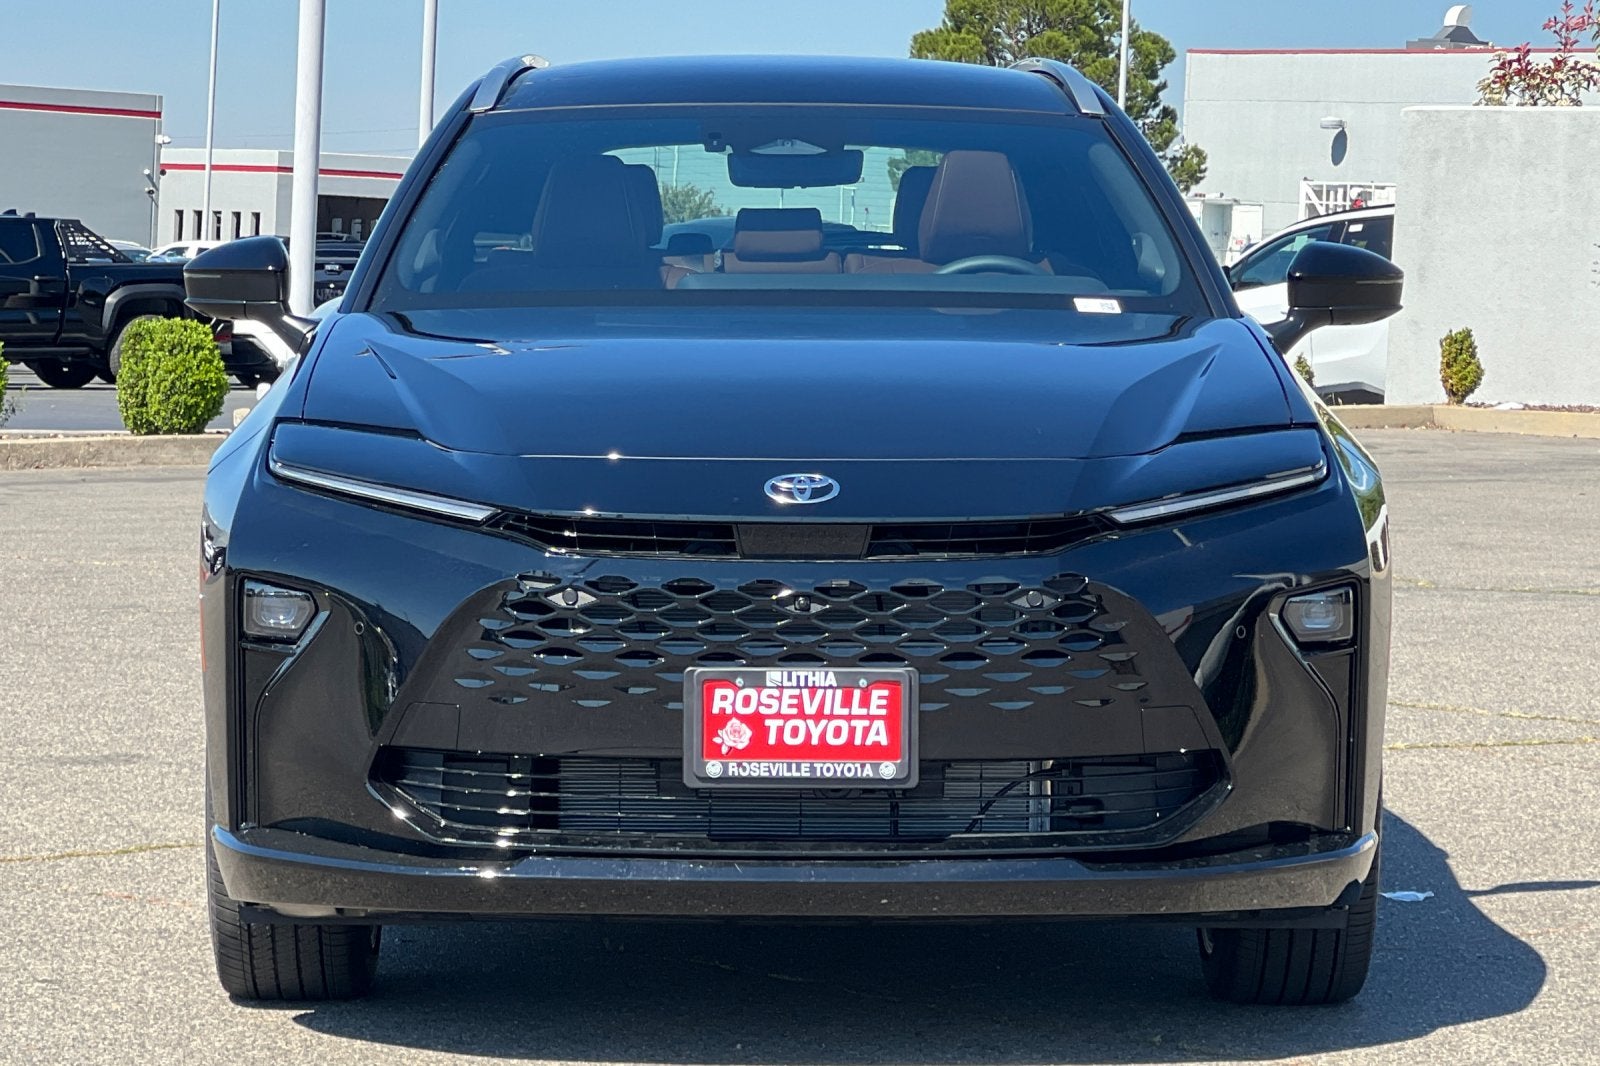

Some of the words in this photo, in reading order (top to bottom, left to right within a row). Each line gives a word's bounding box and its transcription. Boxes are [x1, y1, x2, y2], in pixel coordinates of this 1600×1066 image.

[782, 671, 837, 687] LITHIA
[712, 689, 889, 716] ROSEVILLE
[764, 719, 888, 746] TOYOTA
[729, 762, 810, 777] ROSEVILLE
[813, 763, 873, 778] TOYOTA
